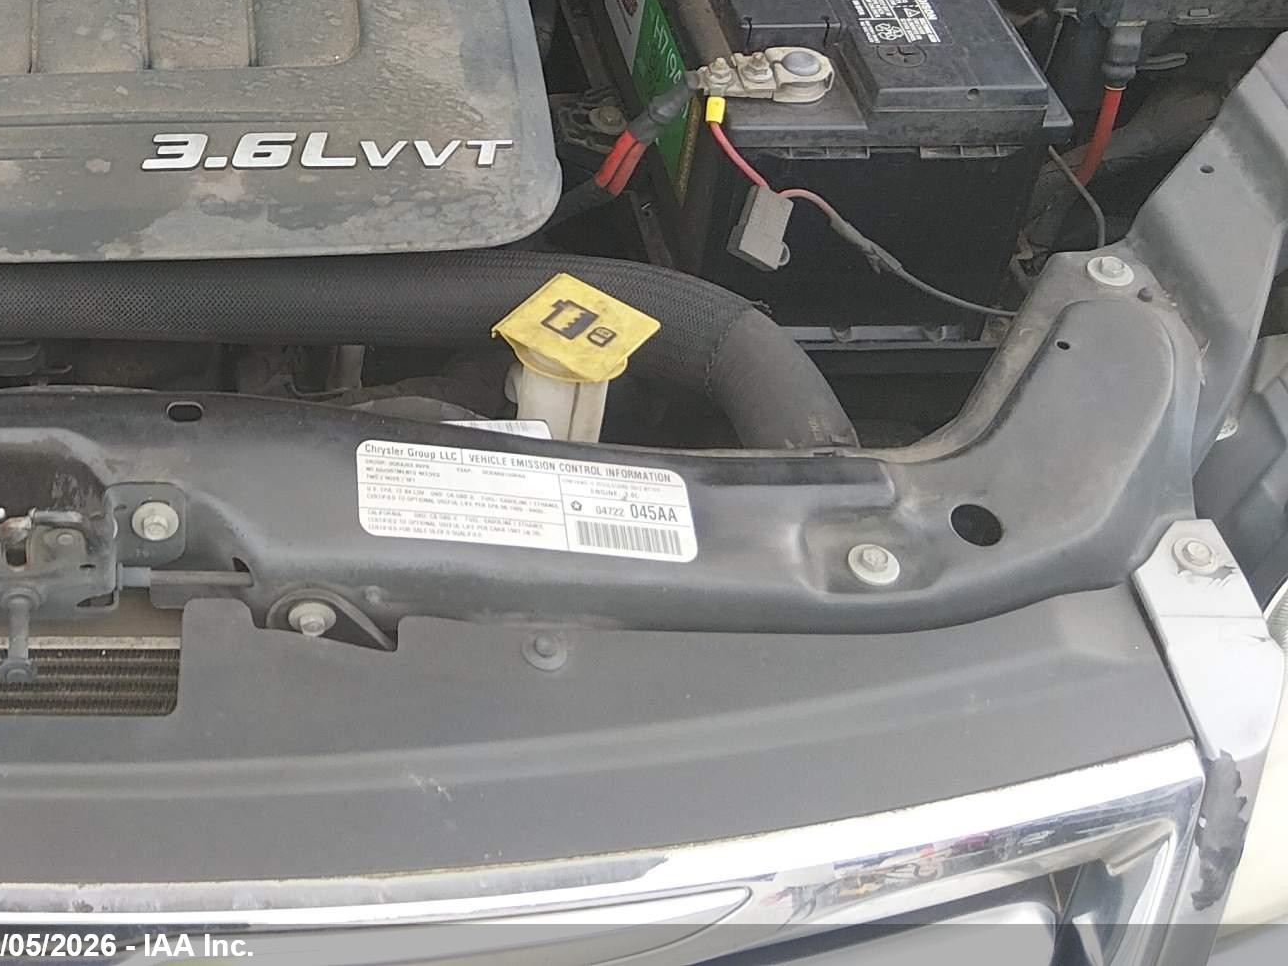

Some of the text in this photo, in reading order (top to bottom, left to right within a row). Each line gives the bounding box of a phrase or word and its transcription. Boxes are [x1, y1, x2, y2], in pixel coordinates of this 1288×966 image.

[364, 443, 458, 461] Chrysler Group LLC
[468, 454, 672, 483] VEHICLE EMISSION CONTROL INFORMATION
[595, 505, 625, 518] 04722
[630, 502, 679, 523] 045AA
